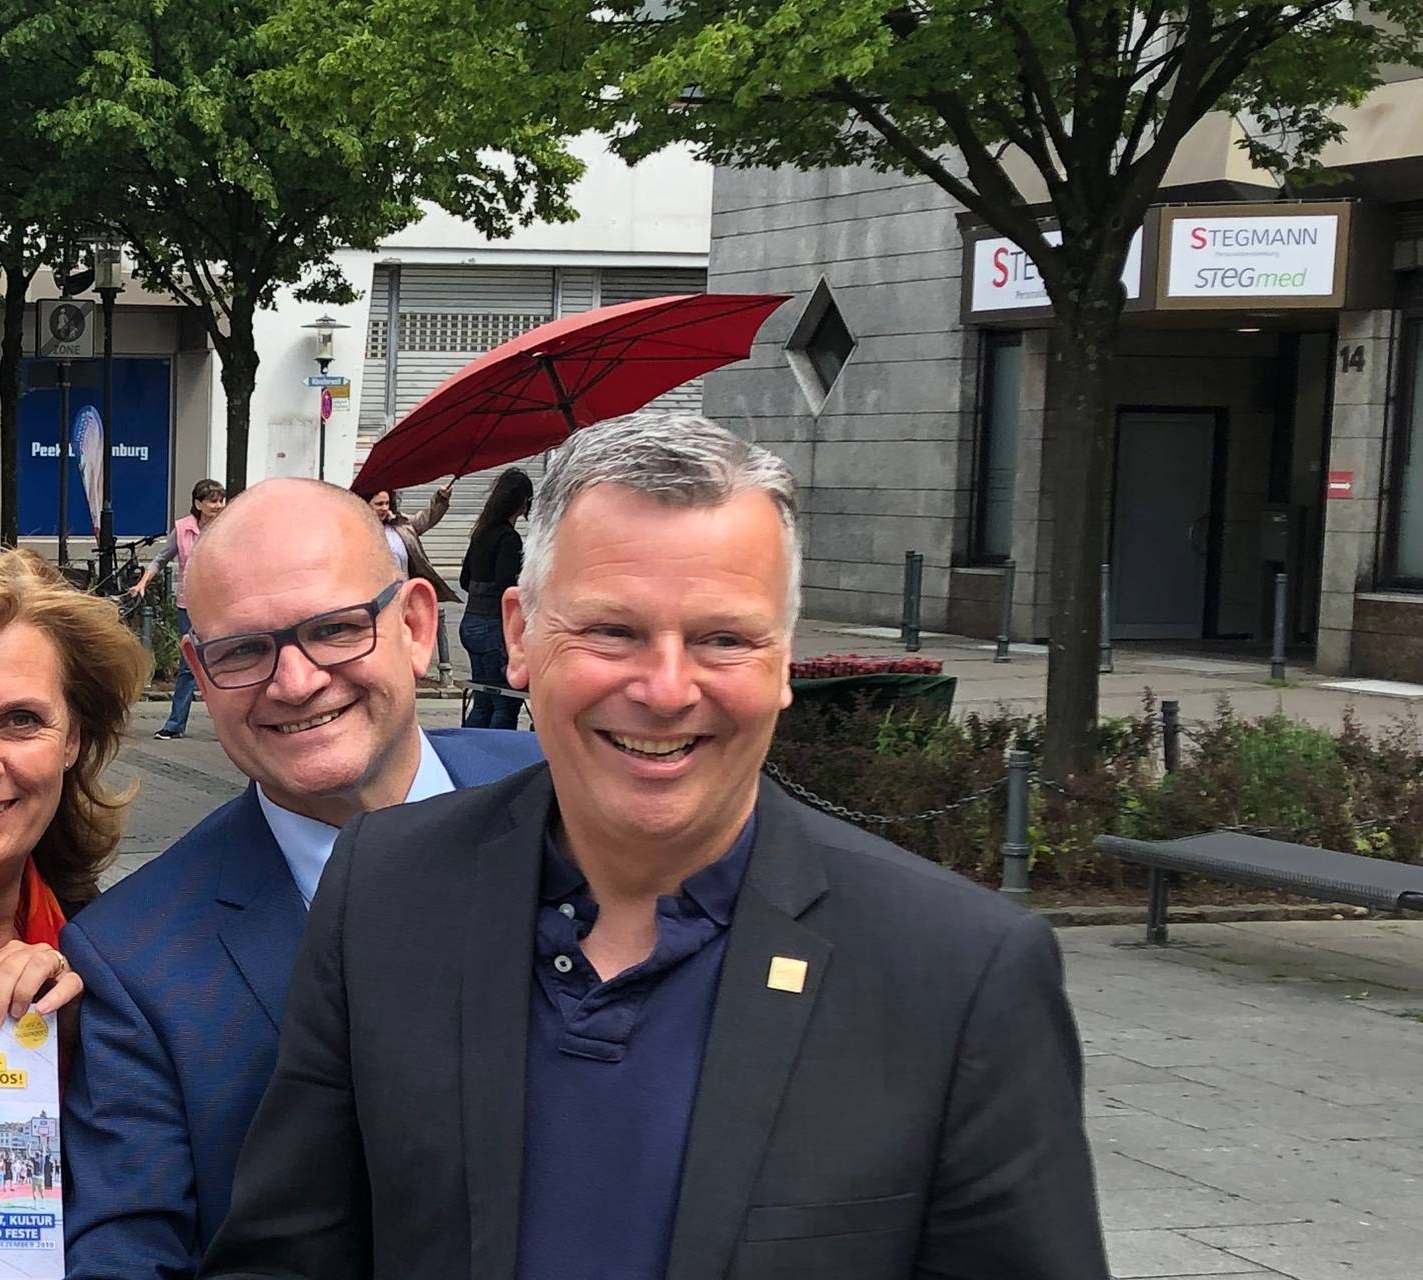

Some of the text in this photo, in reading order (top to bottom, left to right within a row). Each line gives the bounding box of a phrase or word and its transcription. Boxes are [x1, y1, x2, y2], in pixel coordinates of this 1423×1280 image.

[1190, 226, 1318, 250] STEGMANN
[53, 345, 81, 354] ZONE
[1339, 345, 1366, 373] 14
[9, 1215, 53, 1226] KULTUR
[5, 1228, 39, 1239] FESTE
